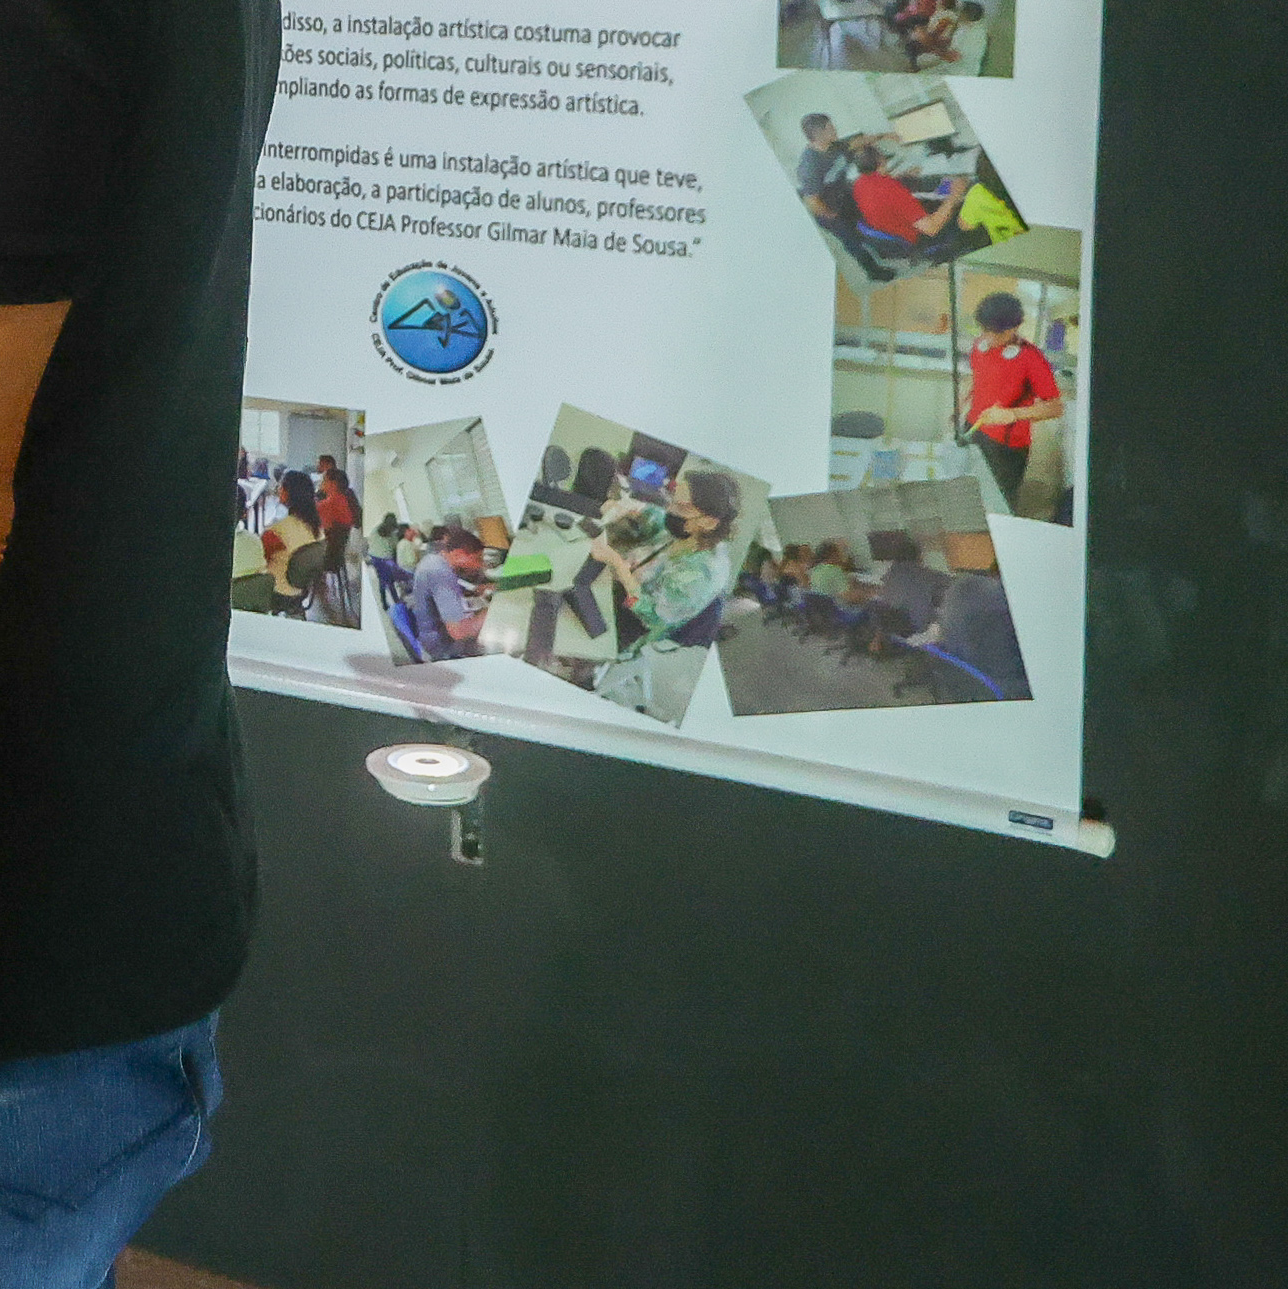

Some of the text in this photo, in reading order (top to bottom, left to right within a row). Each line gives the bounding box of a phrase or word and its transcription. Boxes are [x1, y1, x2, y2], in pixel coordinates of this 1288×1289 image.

[282, 12, 682, 49] disso, a instalação artística costuma provocar
[317, 47, 674, 87] sociais, políticas, culturais ou sensoriais,
[384, 145, 394, 168] é
[399, 152, 437, 170] uma
[442, 152, 531, 180] instalação
[536, 158, 610, 182] artística
[614, 167, 651, 190] que
[656, 168, 704, 193] teve,
[271, 171, 367, 200] elaboração,
[371, 183, 381, 199] a
[386, 183, 493, 210] participação
[498, 188, 521, 209] de
[525, 190, 591, 219] alunos,
[597, 197, 707, 225] professores
[330, 209, 352, 229] do
[356, 211, 397, 232] CEJA
[401, 214, 483, 240] Professor
[487, 220, 547, 245] Gilmar
[553, 226, 599, 250] Maia
[603, 231, 627, 253] de
